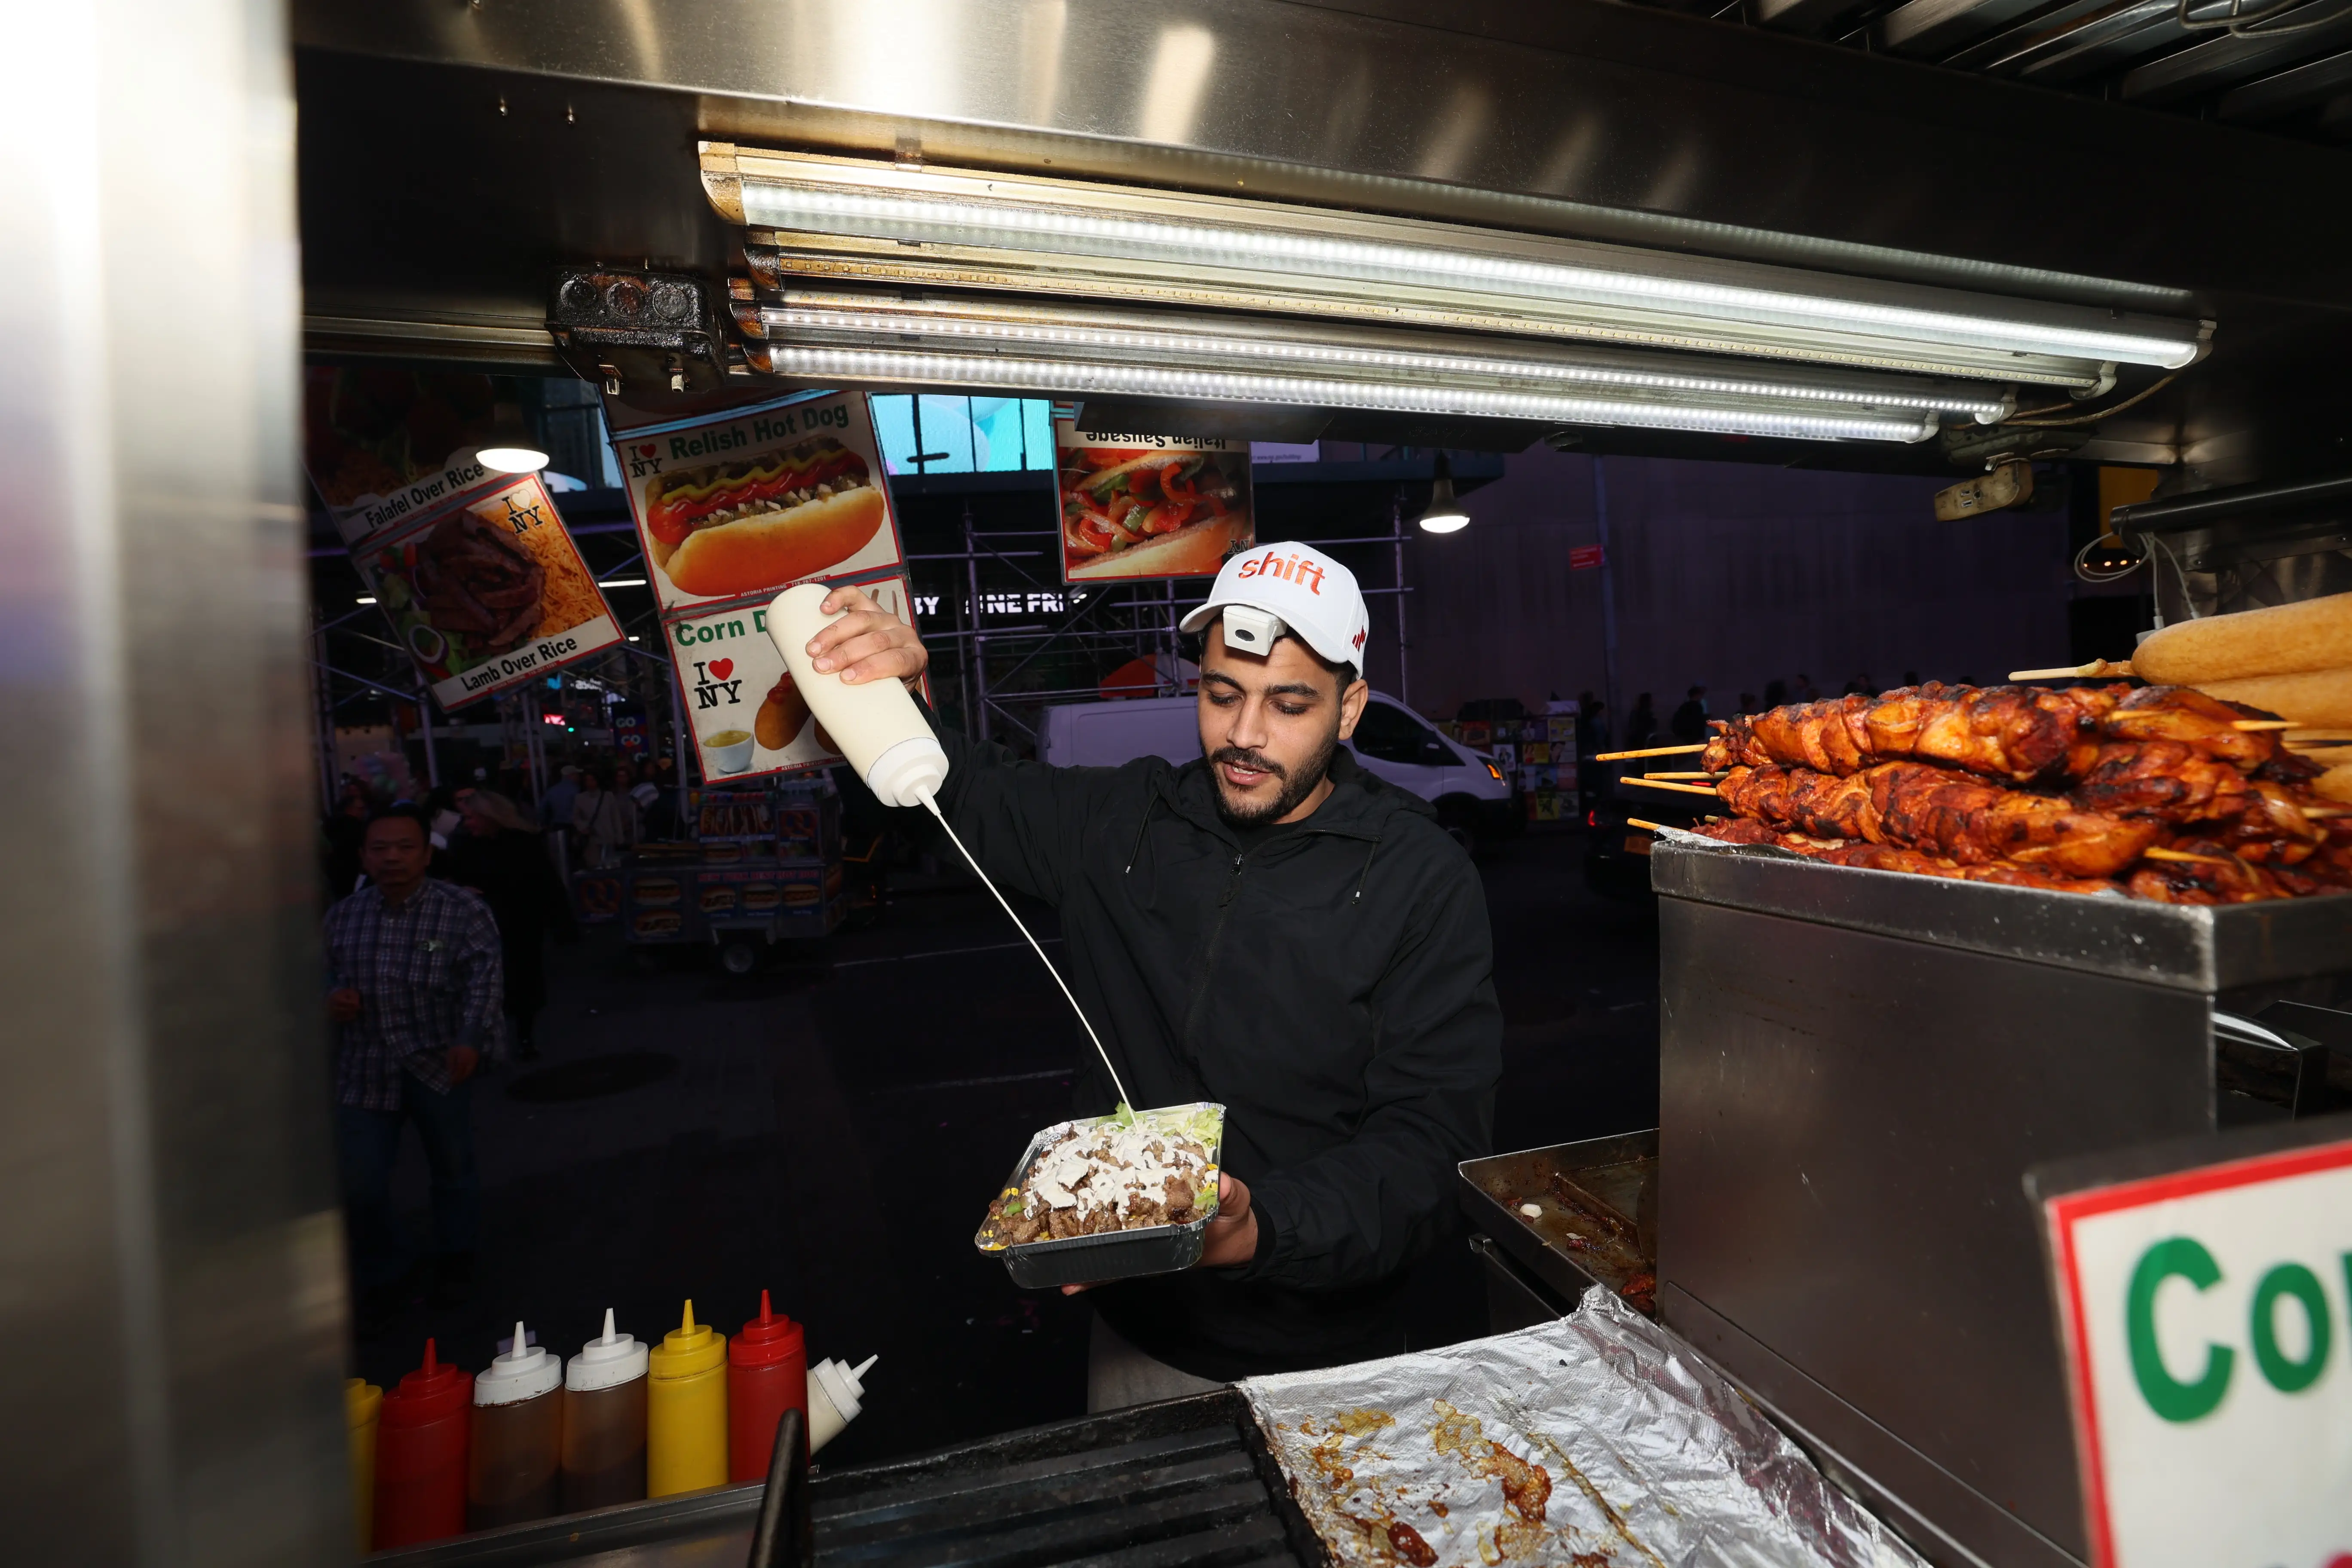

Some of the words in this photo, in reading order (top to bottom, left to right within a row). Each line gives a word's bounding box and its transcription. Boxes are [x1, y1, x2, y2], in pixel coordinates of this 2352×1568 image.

[669, 426, 747, 459] Relish
[753, 414, 797, 442] Hot
[802, 404, 849, 430] Dog
[629, 446, 640, 461] I
[630, 458, 662, 478] NY
[365, 495, 409, 528] Falafel
[411, 480, 444, 505] Over
[445, 463, 484, 489] Rice
[502, 496, 517, 514] I
[508, 505, 542, 534] NY
[741, 588, 763, 597] ASTORIA
[763, 584, 787, 593] PRINTING
[791, 576, 827, 587] 718-267-1201
[1238, 551, 1325, 596] shift
[676, 620, 745, 646] Corn
[461, 667, 501, 691] Lamb
[501, 652, 537, 675] Over
[537, 638, 577, 661] Rice
[693, 662, 710, 686] I
[694, 679, 742, 710] NY
